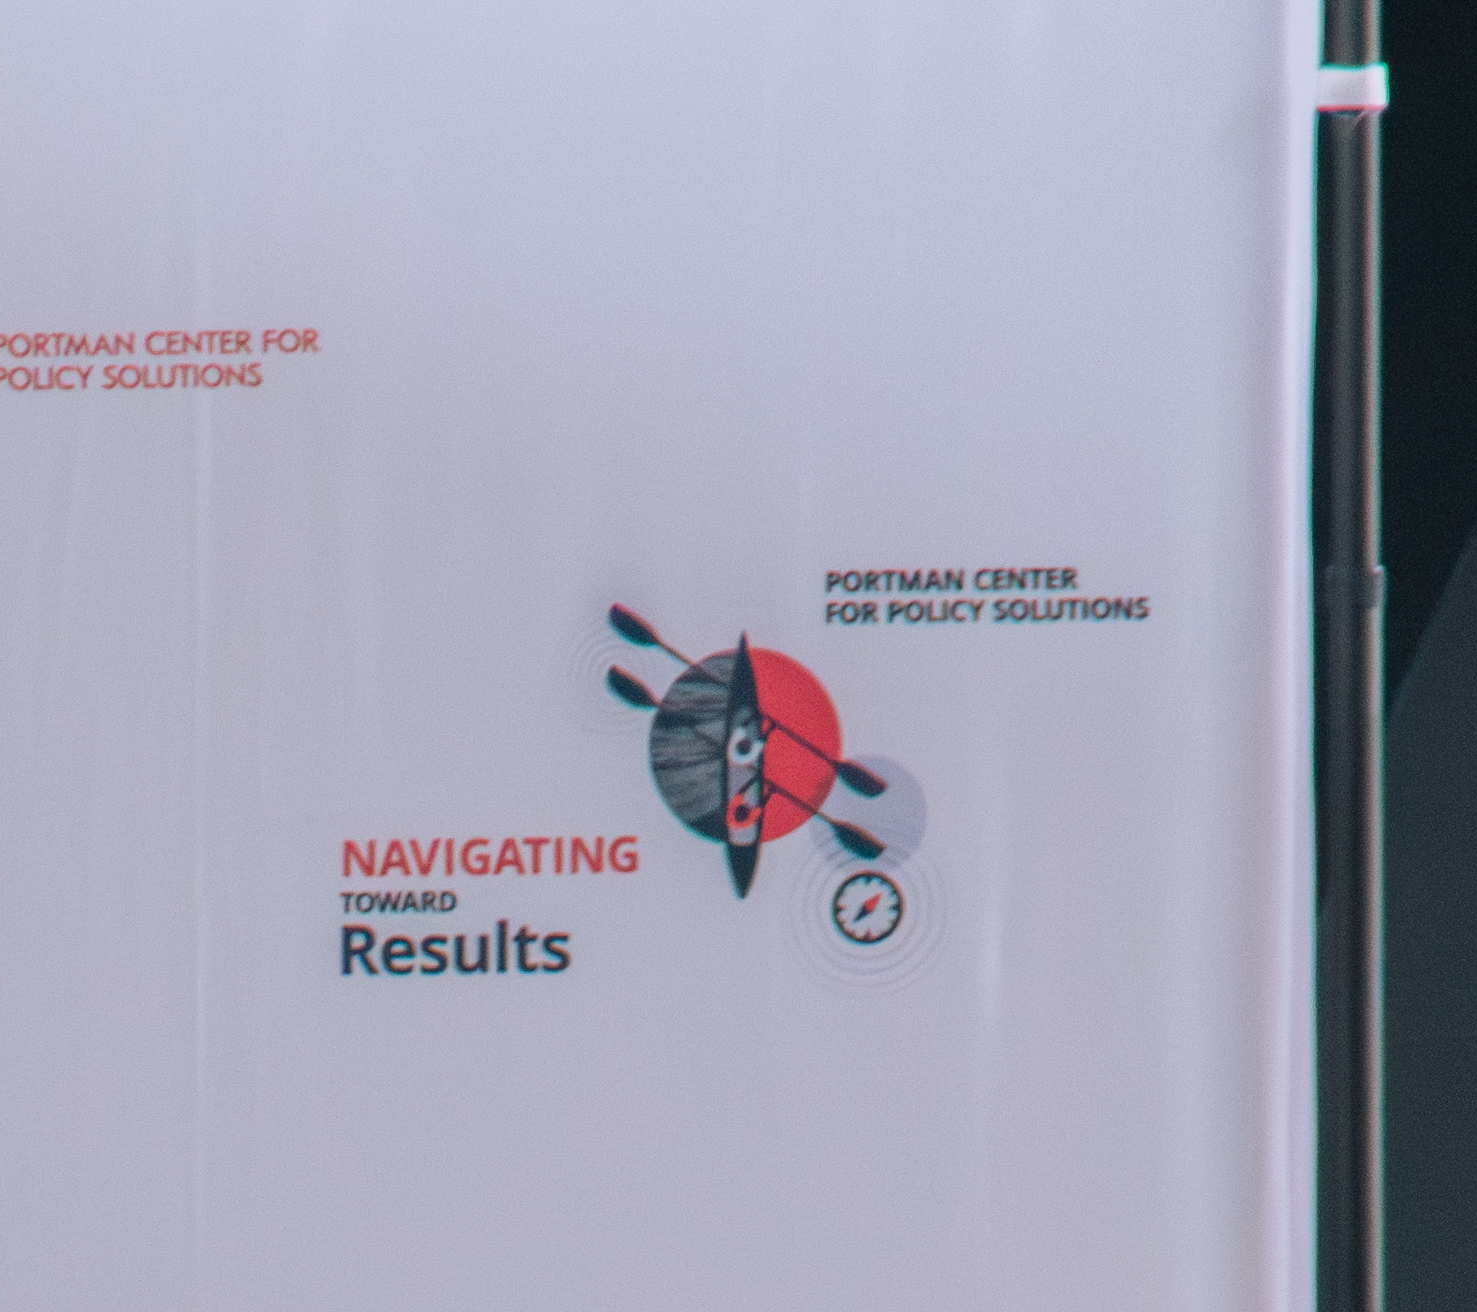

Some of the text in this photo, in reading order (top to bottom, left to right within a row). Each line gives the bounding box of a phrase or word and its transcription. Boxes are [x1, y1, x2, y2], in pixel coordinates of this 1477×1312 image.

[144, 330, 252, 357] CENTER
[262, 328, 319, 354] FOR
[102, 362, 263, 390] SOLUTIONS
[824, 567, 1078, 594] PORTMAN CENTER
[824, 596, 1150, 626] FOR POLICY SOLUTIONS
[340, 835, 640, 877] NAVIGATING
[339, 889, 458, 914] TOWARD
[339, 919, 572, 976] Results
